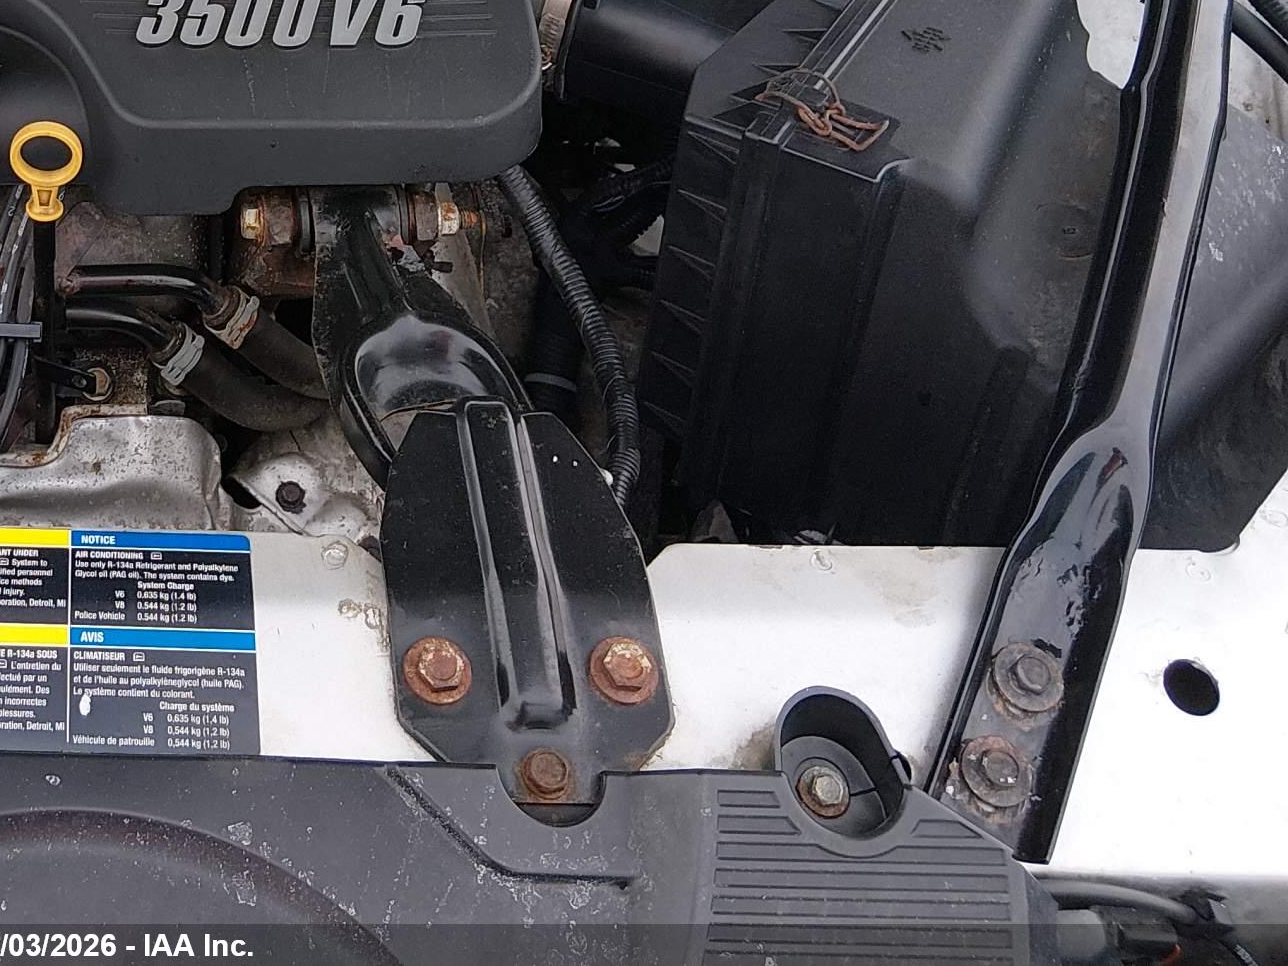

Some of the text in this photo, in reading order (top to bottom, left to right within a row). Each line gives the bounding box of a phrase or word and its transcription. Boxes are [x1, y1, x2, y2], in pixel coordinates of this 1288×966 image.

[81, 535, 116, 544] NOTICE
[75, 550, 144, 559] AIR CONDITIONING
[11, 558, 39, 567] System
[75, 560, 89, 568] Use
[107, 561, 134, 569] R-134a
[135, 562, 176, 571] Refrigerant
[192, 563, 239, 573] Polyalkylene
[17, 568, 53, 578] personnel
[74, 570, 97, 579] Glycol
[158, 572, 185, 581] system
[186, 573, 218, 581] contains
[11, 577, 43, 585] methods
[137, 581, 195, 591] System Charge
[115, 590, 125, 598] V6
[115, 601, 125, 609] V8
[74, 611, 97, 619] Police
[98, 612, 126, 620] Vehicle
[80, 631, 104, 642] AVIS
[7, 648, 35, 658] R-134a
[36, 649, 58, 659] SOUS
[73, 651, 126, 661] CLIMATISEUR
[11, 661, 50, 670] L'entretien
[73, 663, 100, 672] Utiliser
[101, 664, 141, 673] seulement
[151, 666, 173, 674] fluide
[217, 668, 245, 676] R-134a
[94, 675, 118, 684] l'huile
[200, 678, 222, 689] (huile
[35, 685, 50, 694] Des
[117, 688, 149, 697] contient
[4, 696, 47, 706] incorrectes
[159, 702, 187, 712] Charge
[143, 713, 154, 721] V6
[143, 725, 154, 734] V8
[119, 737, 155, 747] patrouille
